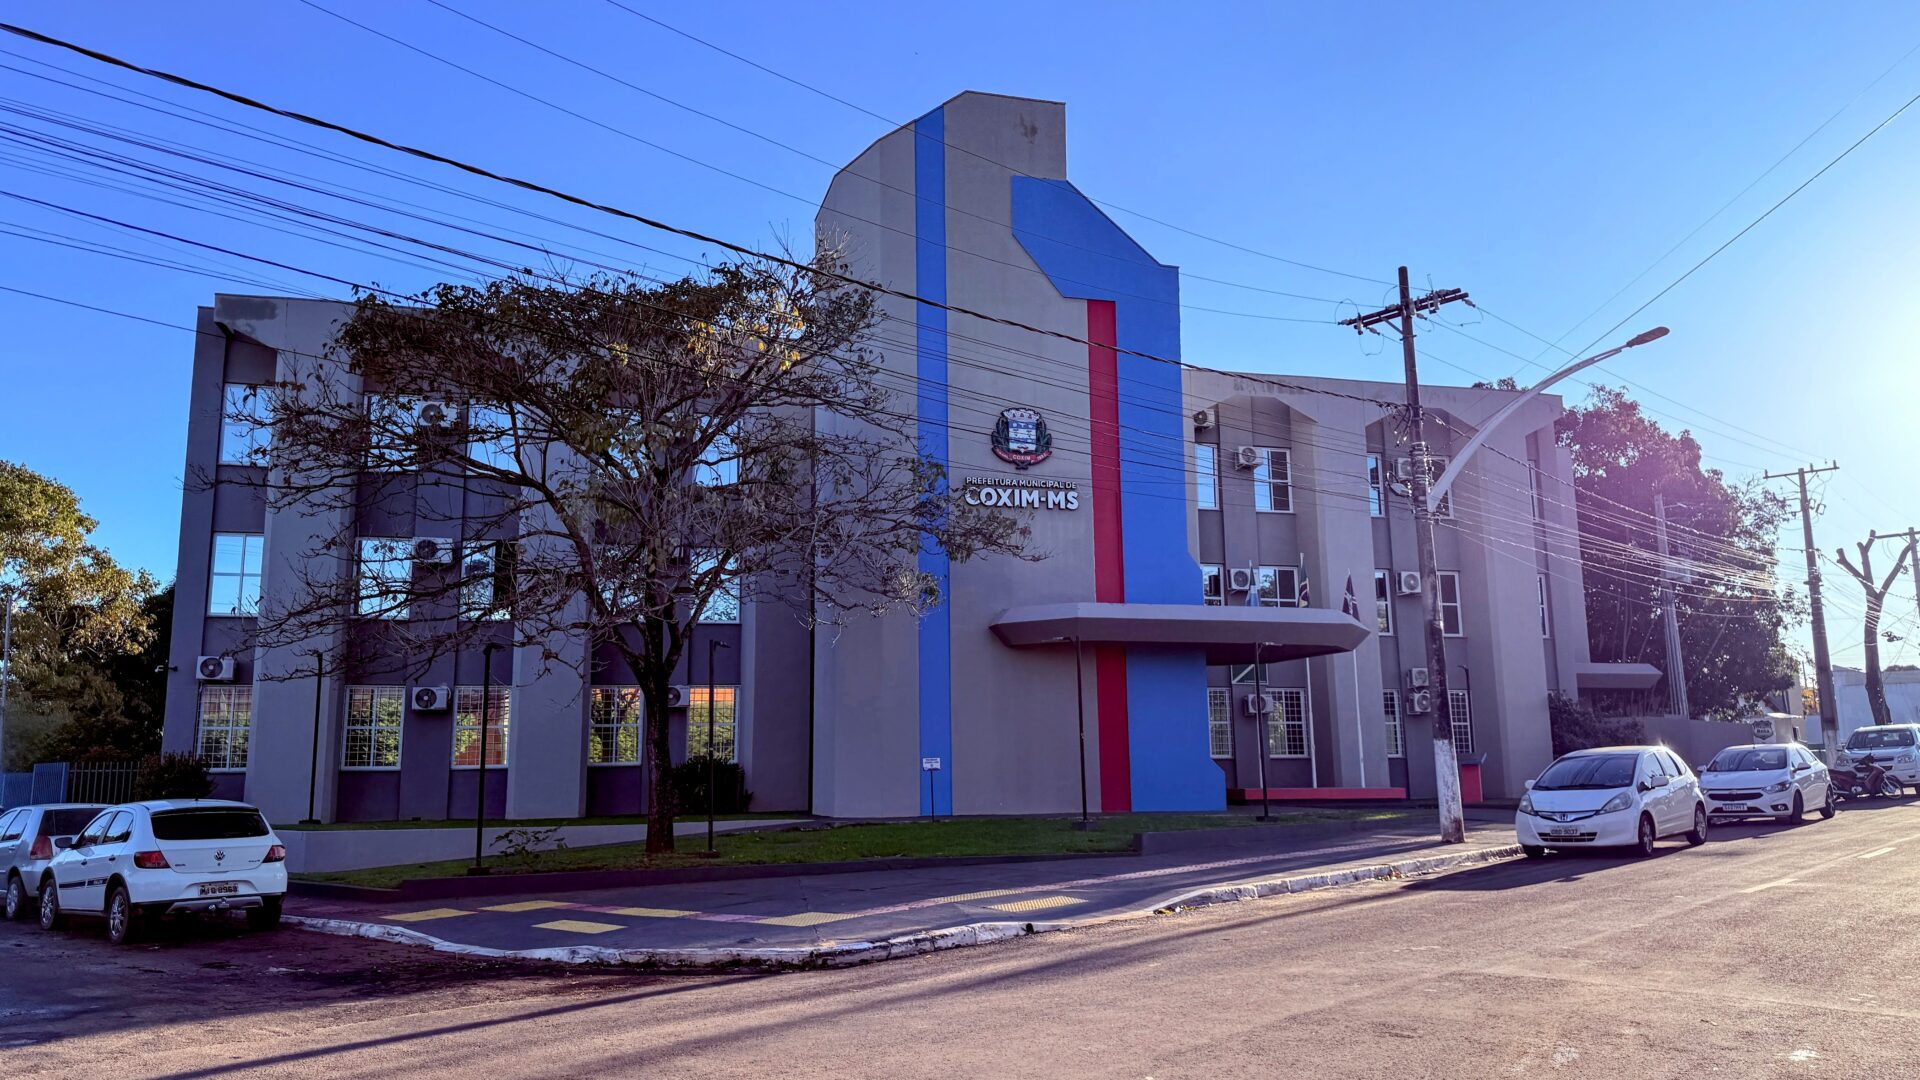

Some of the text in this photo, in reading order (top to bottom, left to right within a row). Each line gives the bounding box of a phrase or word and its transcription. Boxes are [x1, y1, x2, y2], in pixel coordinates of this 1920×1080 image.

[966, 477, 1077, 489] PREFEITURA MUNICIPAL DE
[964, 486, 1079, 510] COXIM-MS
